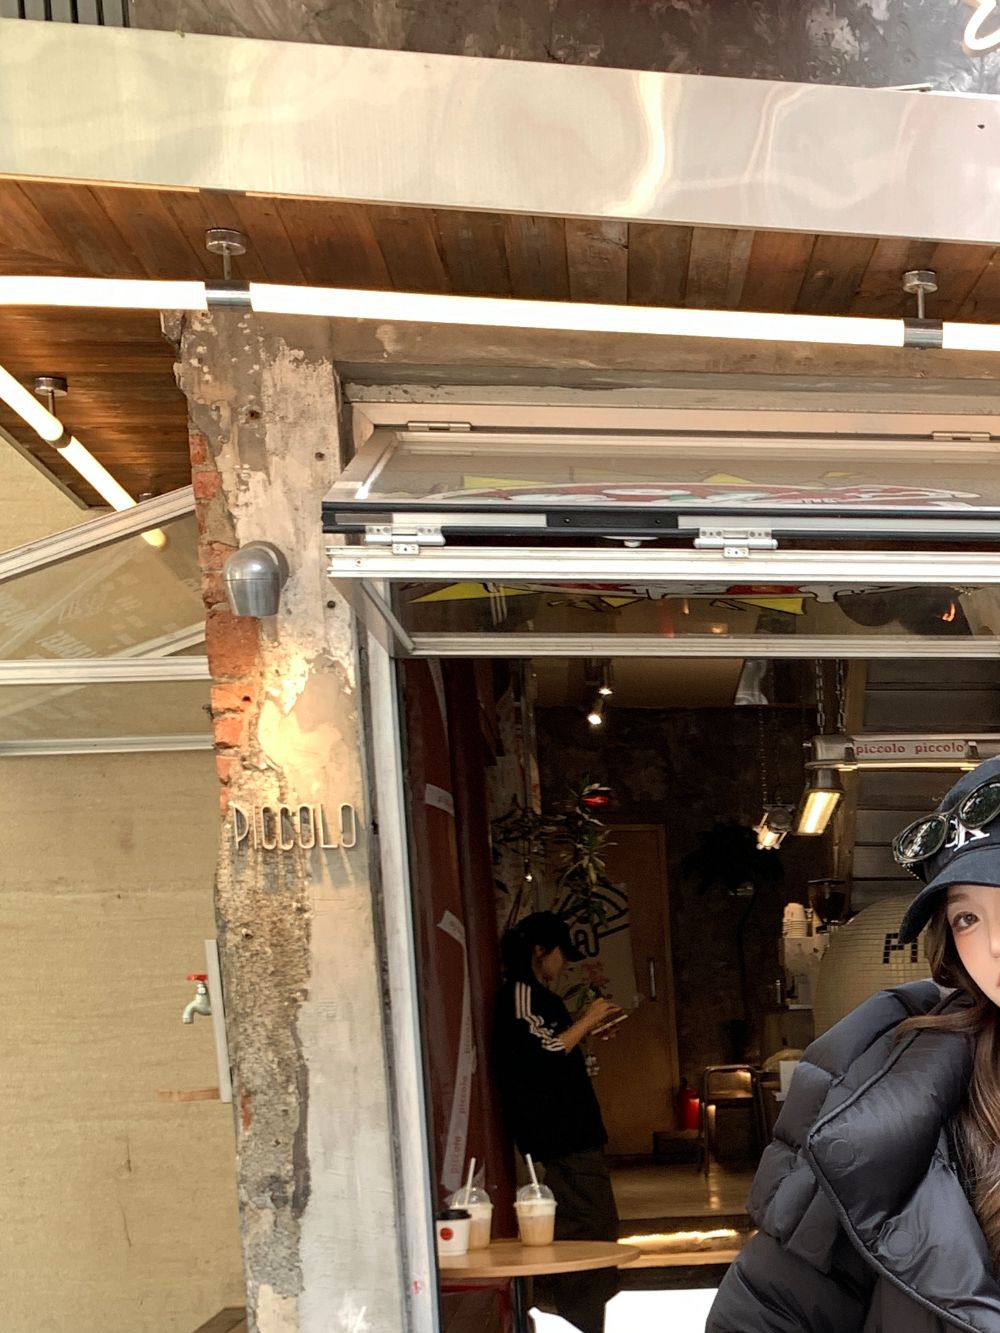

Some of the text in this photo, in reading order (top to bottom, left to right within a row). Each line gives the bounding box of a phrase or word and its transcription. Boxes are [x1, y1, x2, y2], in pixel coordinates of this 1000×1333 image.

[856, 741, 964, 756] piccolo piccolo
[229, 801, 357, 850] PICCOLO
